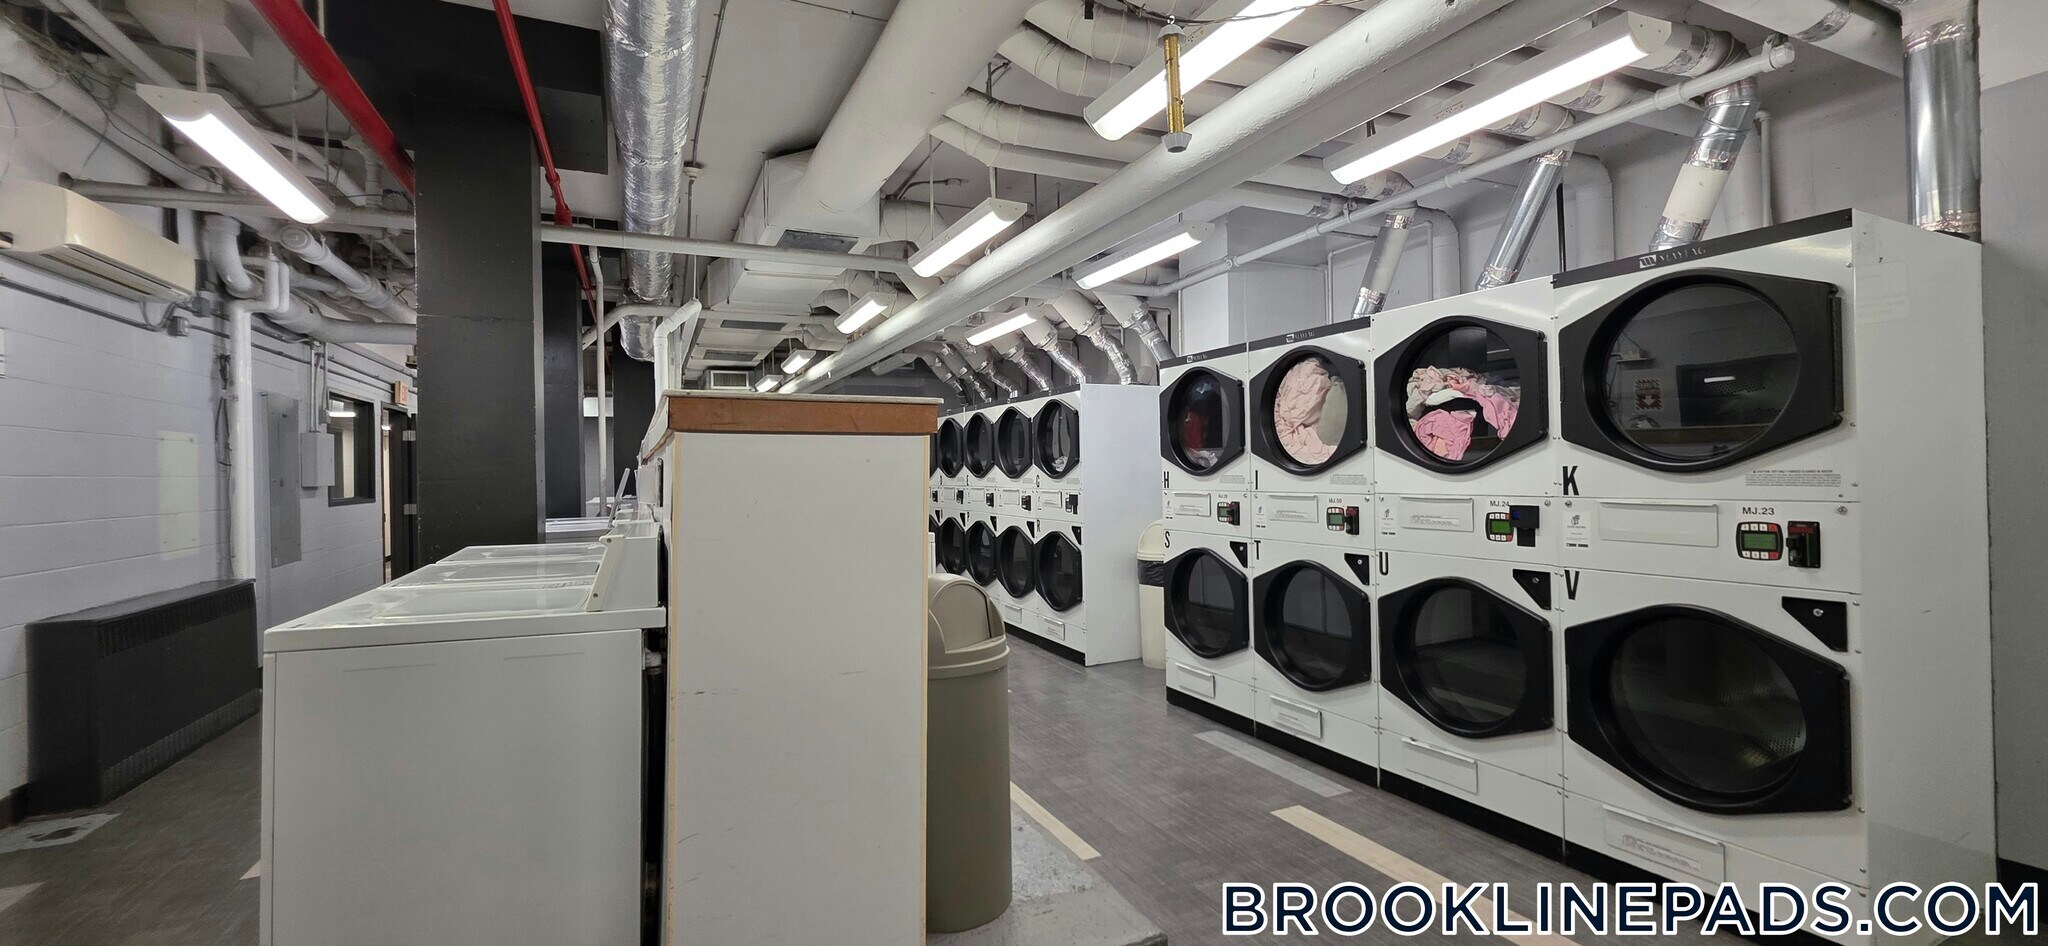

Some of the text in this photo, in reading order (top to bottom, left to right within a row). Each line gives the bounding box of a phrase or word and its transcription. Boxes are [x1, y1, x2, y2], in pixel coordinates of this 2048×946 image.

[1036, 474, 1040, 488] G
[1163, 471, 1170, 489] H
[1562, 466, 1579, 496] K
[1489, 500, 1510, 508] MJ.24
[1742, 506, 1775, 516] MJ.23
[1164, 530, 1171, 549] S
[1253, 540, 1261, 560] T
[1379, 551, 1389, 576] U
[1563, 569, 1580, 600] V
